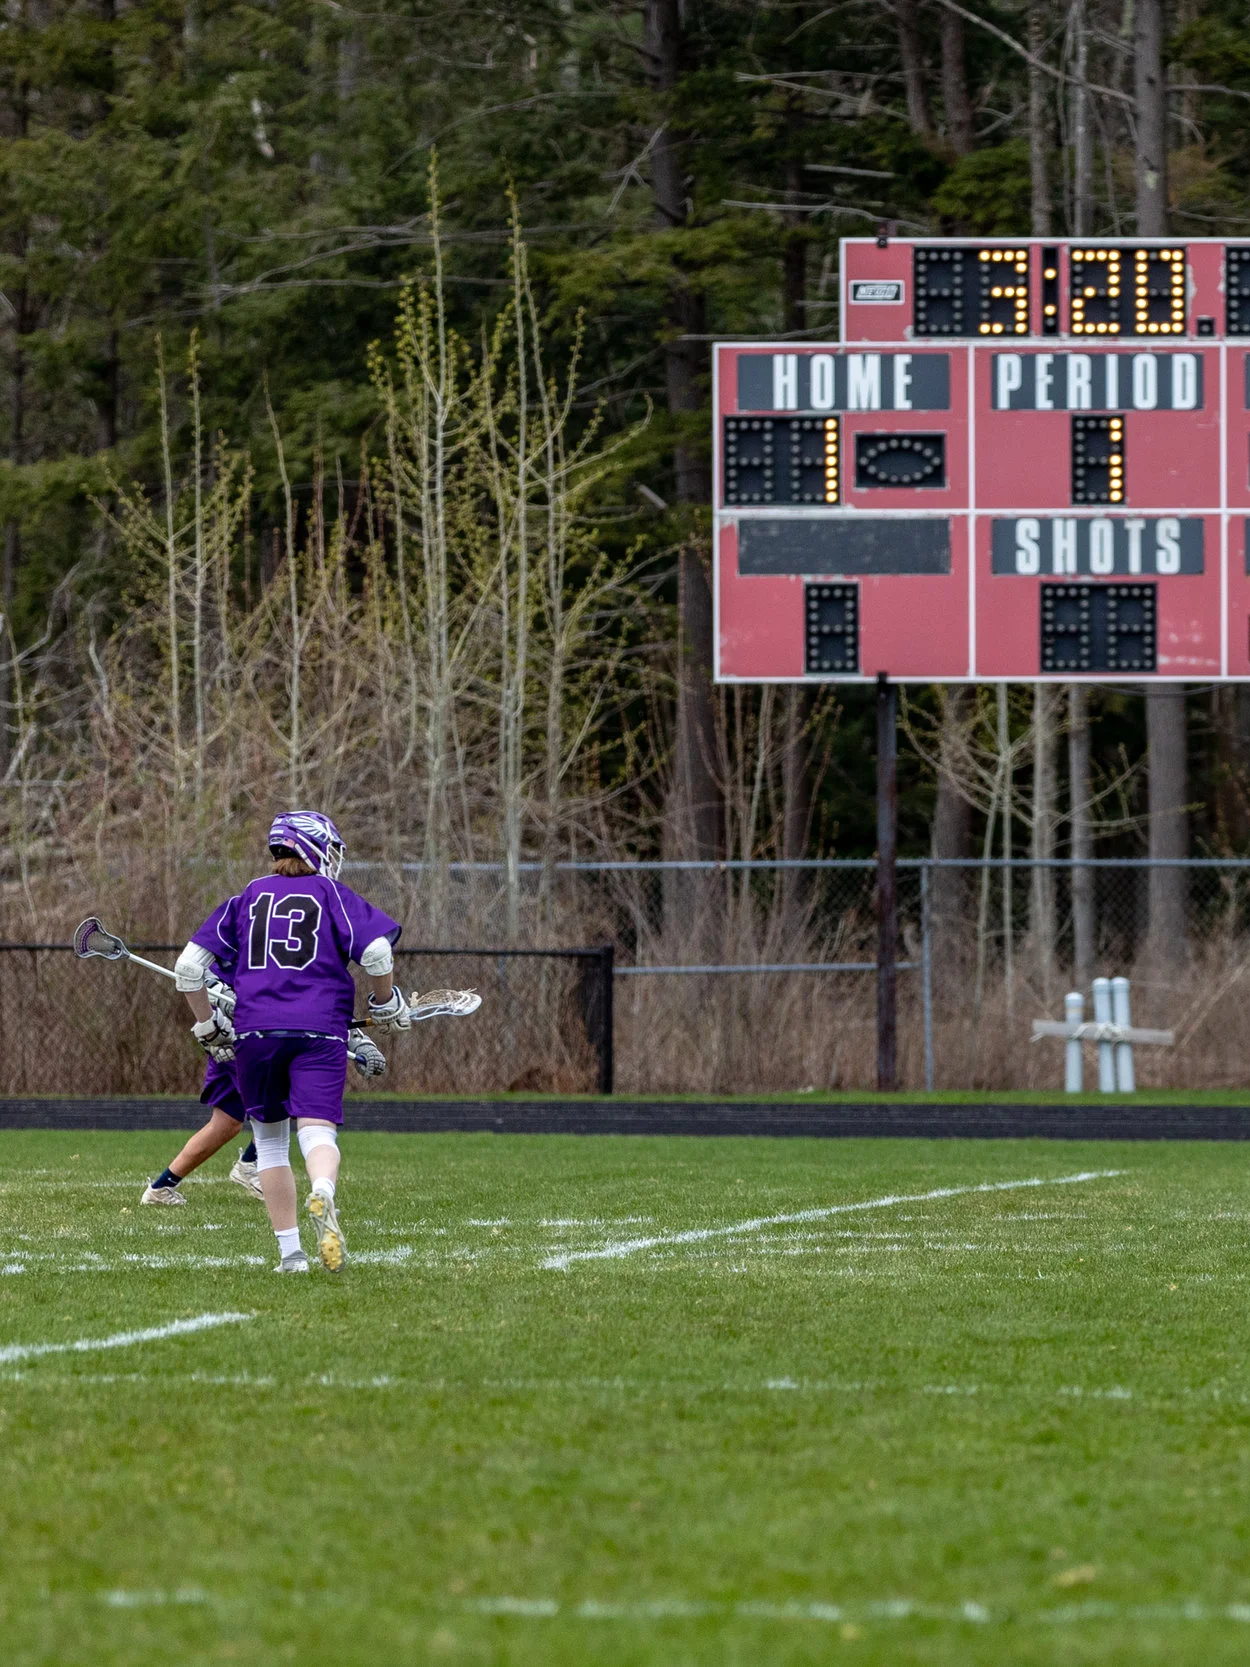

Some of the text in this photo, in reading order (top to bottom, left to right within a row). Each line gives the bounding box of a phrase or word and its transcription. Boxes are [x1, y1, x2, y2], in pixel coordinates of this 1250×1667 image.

[978, 248, 1186, 335] 3:20
[772, 353, 914, 411] HOME
[996, 352, 1199, 410] PERIOD
[824, 416, 839, 503] 1
[1109, 416, 1124, 504] 1
[1015, 517, 1182, 575] SHOTS
[248, 892, 322, 970] 13
